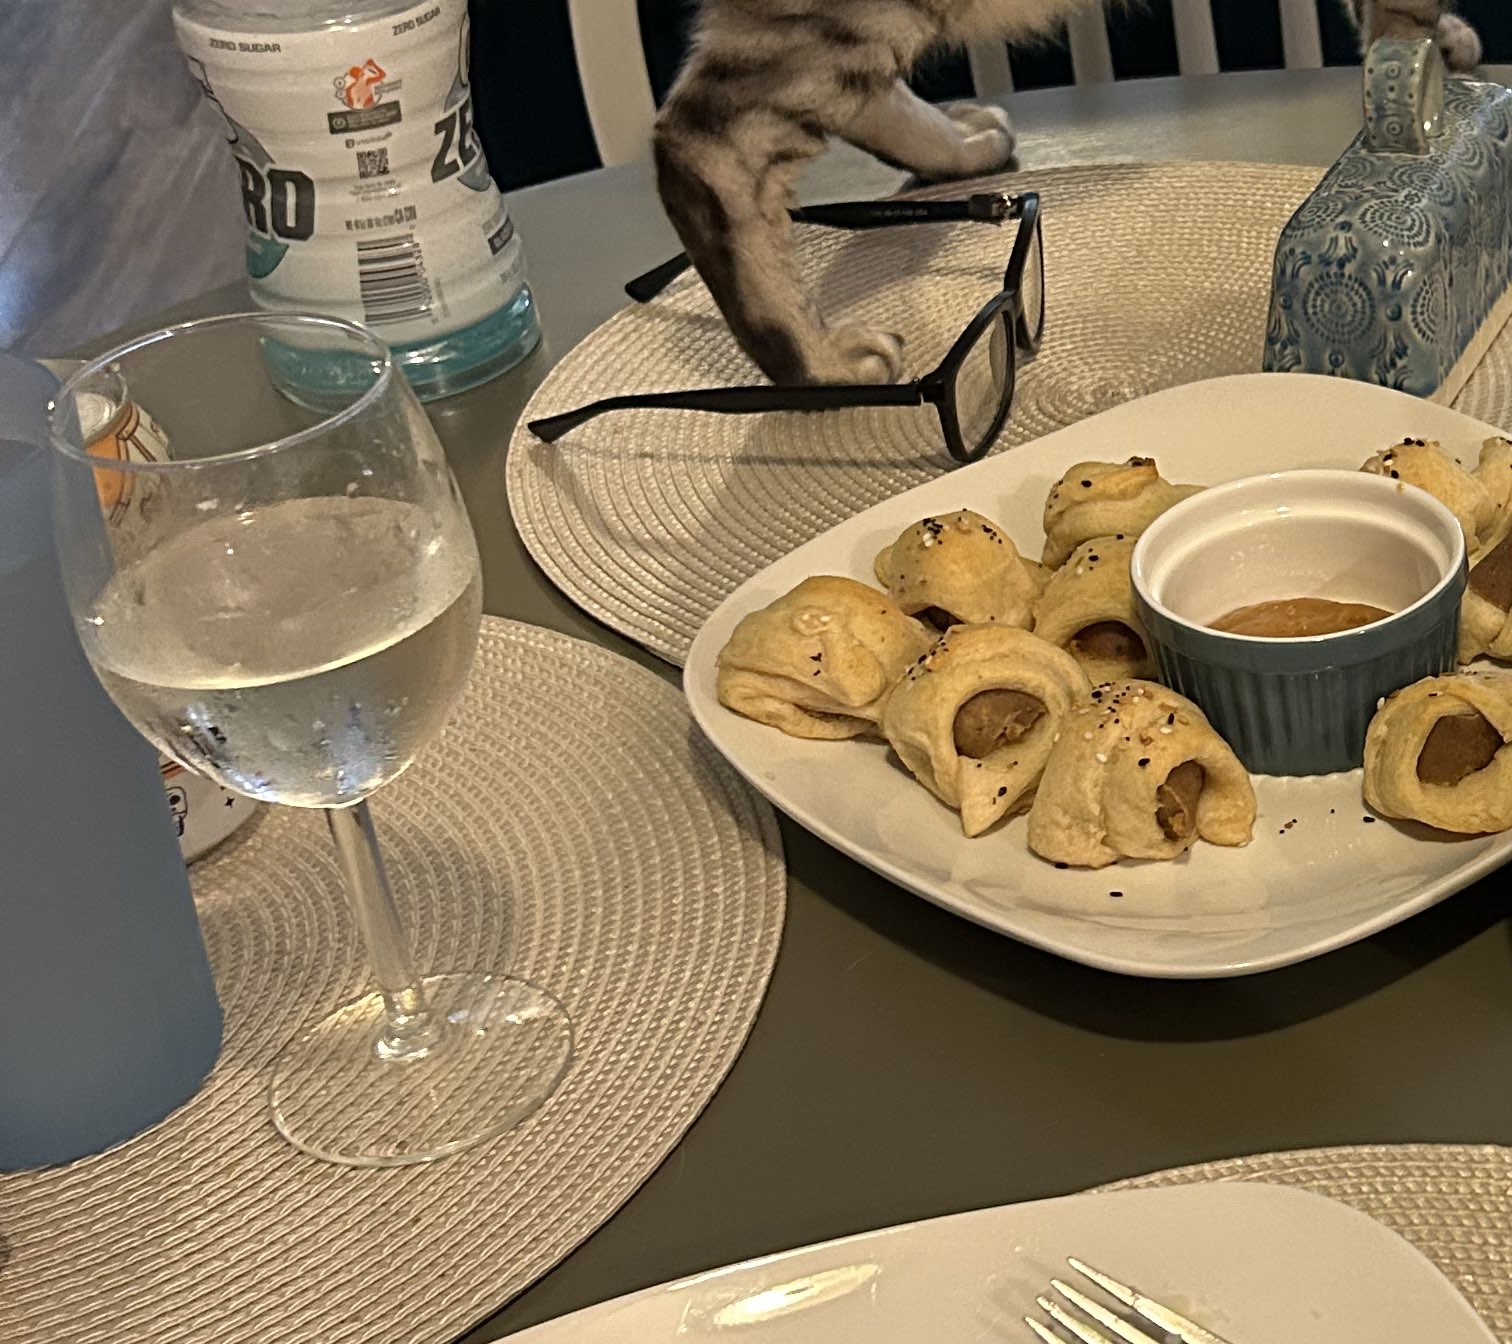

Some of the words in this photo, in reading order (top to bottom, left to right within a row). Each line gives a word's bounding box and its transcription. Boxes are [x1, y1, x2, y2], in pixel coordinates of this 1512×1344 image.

[392, 19, 416, 36] ZERO
[415, 6, 441, 27] SUGAR
[209, 38, 237, 51] ZERO
[238, 42, 281, 53] SUGAR
[431, 96, 481, 183] ZE
